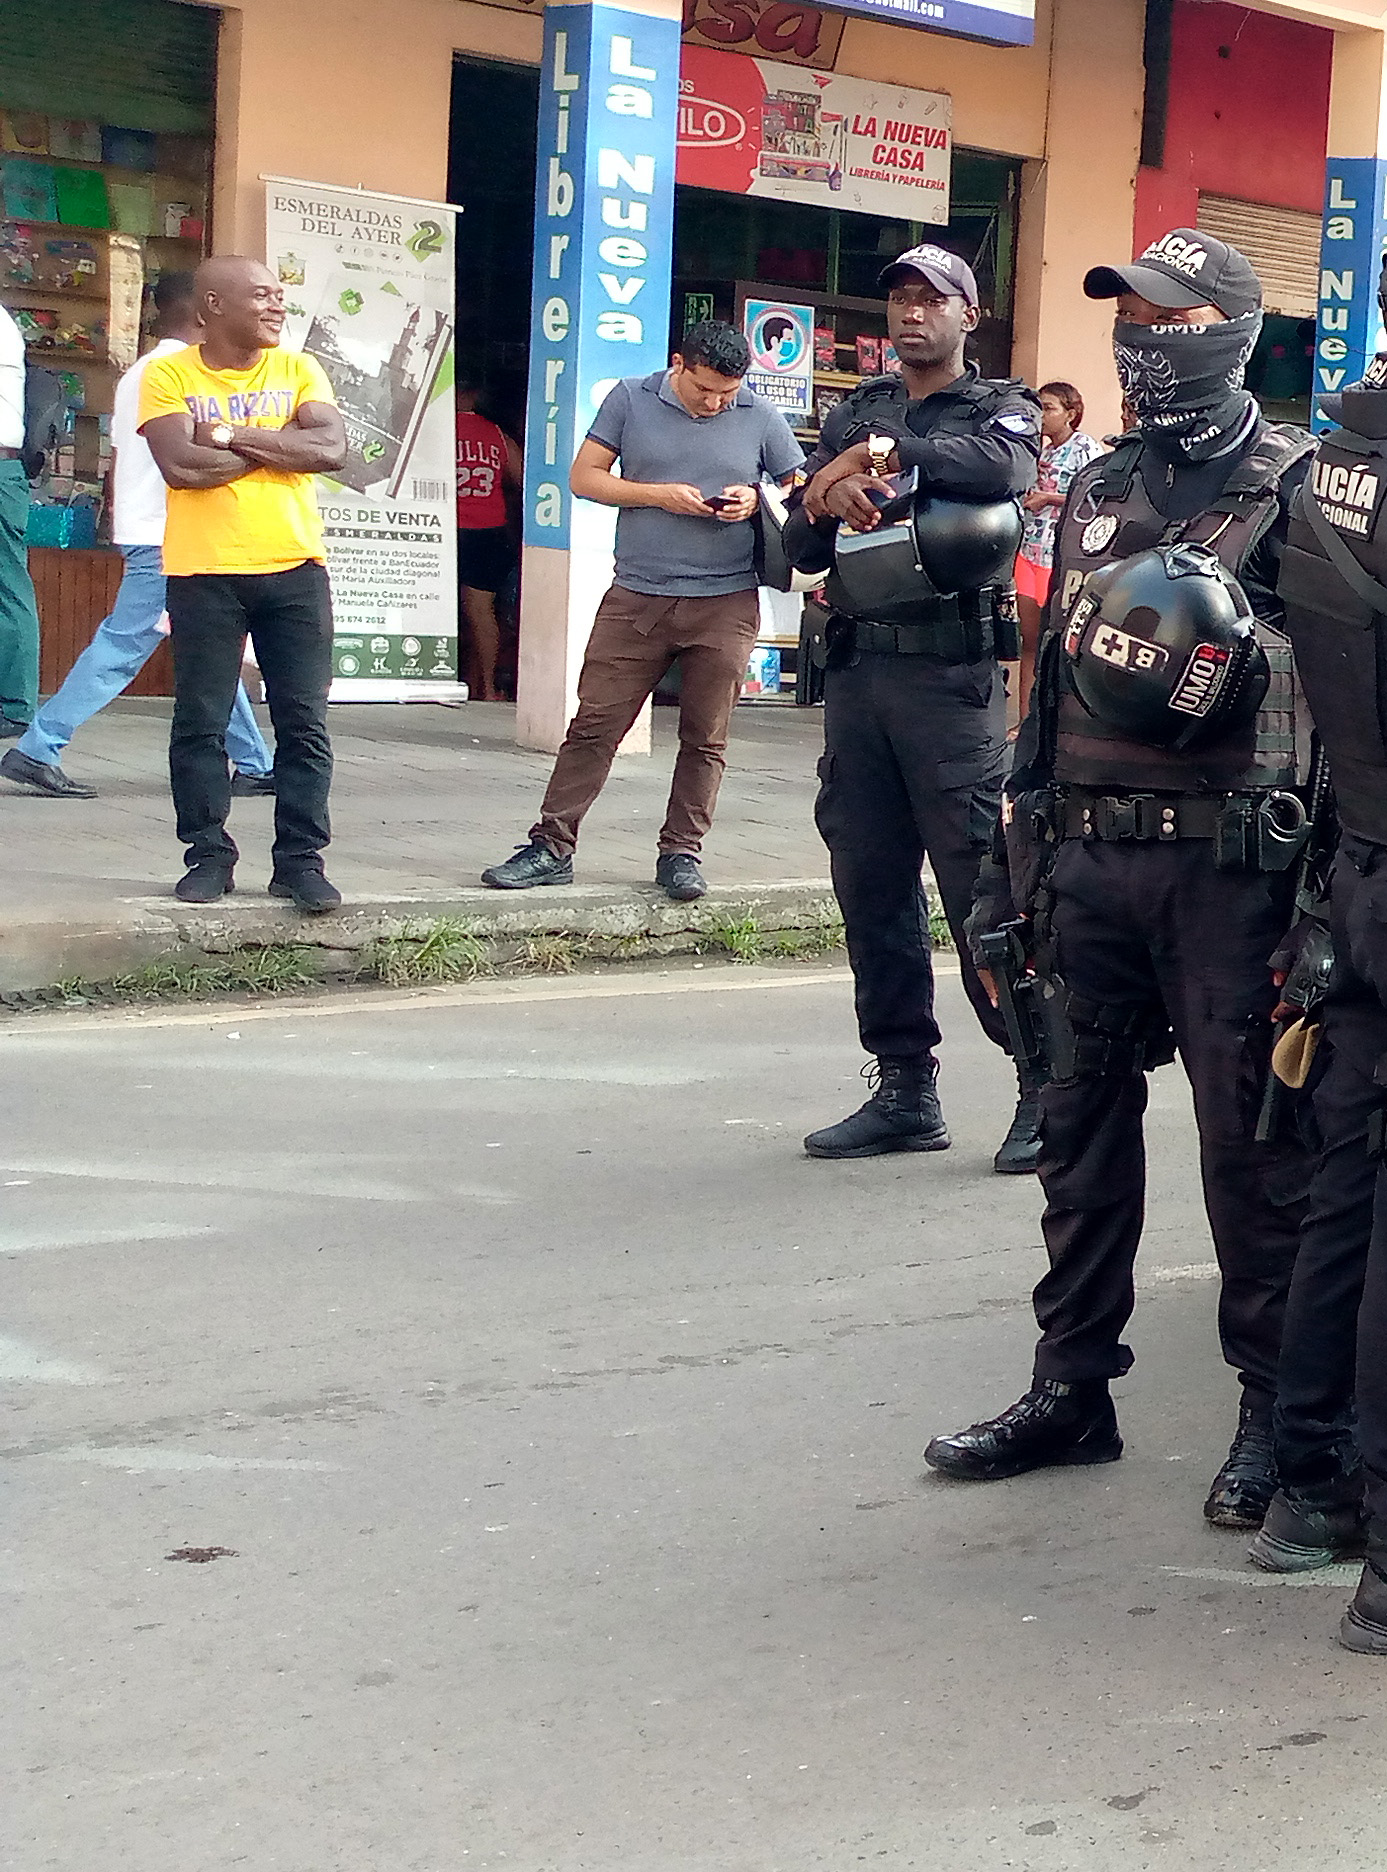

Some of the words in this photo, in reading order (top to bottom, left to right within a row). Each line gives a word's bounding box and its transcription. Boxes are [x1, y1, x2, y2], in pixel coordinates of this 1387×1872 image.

[605, 35, 656, 119] La
[680, 107, 726, 138] ILO
[852, 114, 877, 138] LA
[883, 120, 947, 150] NUEVA
[872, 144, 925, 171] CASA
[849, 167, 890, 182] LIBRERÍA
[892, 173, 898, 183] Y
[898, 175, 945, 191] PAPELERÍA
[273, 196, 402, 229] ESMERALDAS
[301, 217, 342, 237] DEL
[351, 226, 402, 246] AYER
[413, 220, 442, 253] 2
[595, 147, 655, 345] Nueva
[534, 30, 579, 527] Librería
[749, 374, 806, 389] OBLIGATORIO
[756, 384, 768, 396] EL
[769, 385, 785, 397] USO
[786, 387, 797, 398] DE
[457, 440, 501, 470] ULLS
[457, 467, 496, 498] 23
[1312, 459, 1378, 510] LICÍA
[318, 506, 352, 522] TOS
[357, 509, 381, 523] DE
[385, 511, 441, 527] VENTA
[1317, 501, 1368, 534] CIONAL
